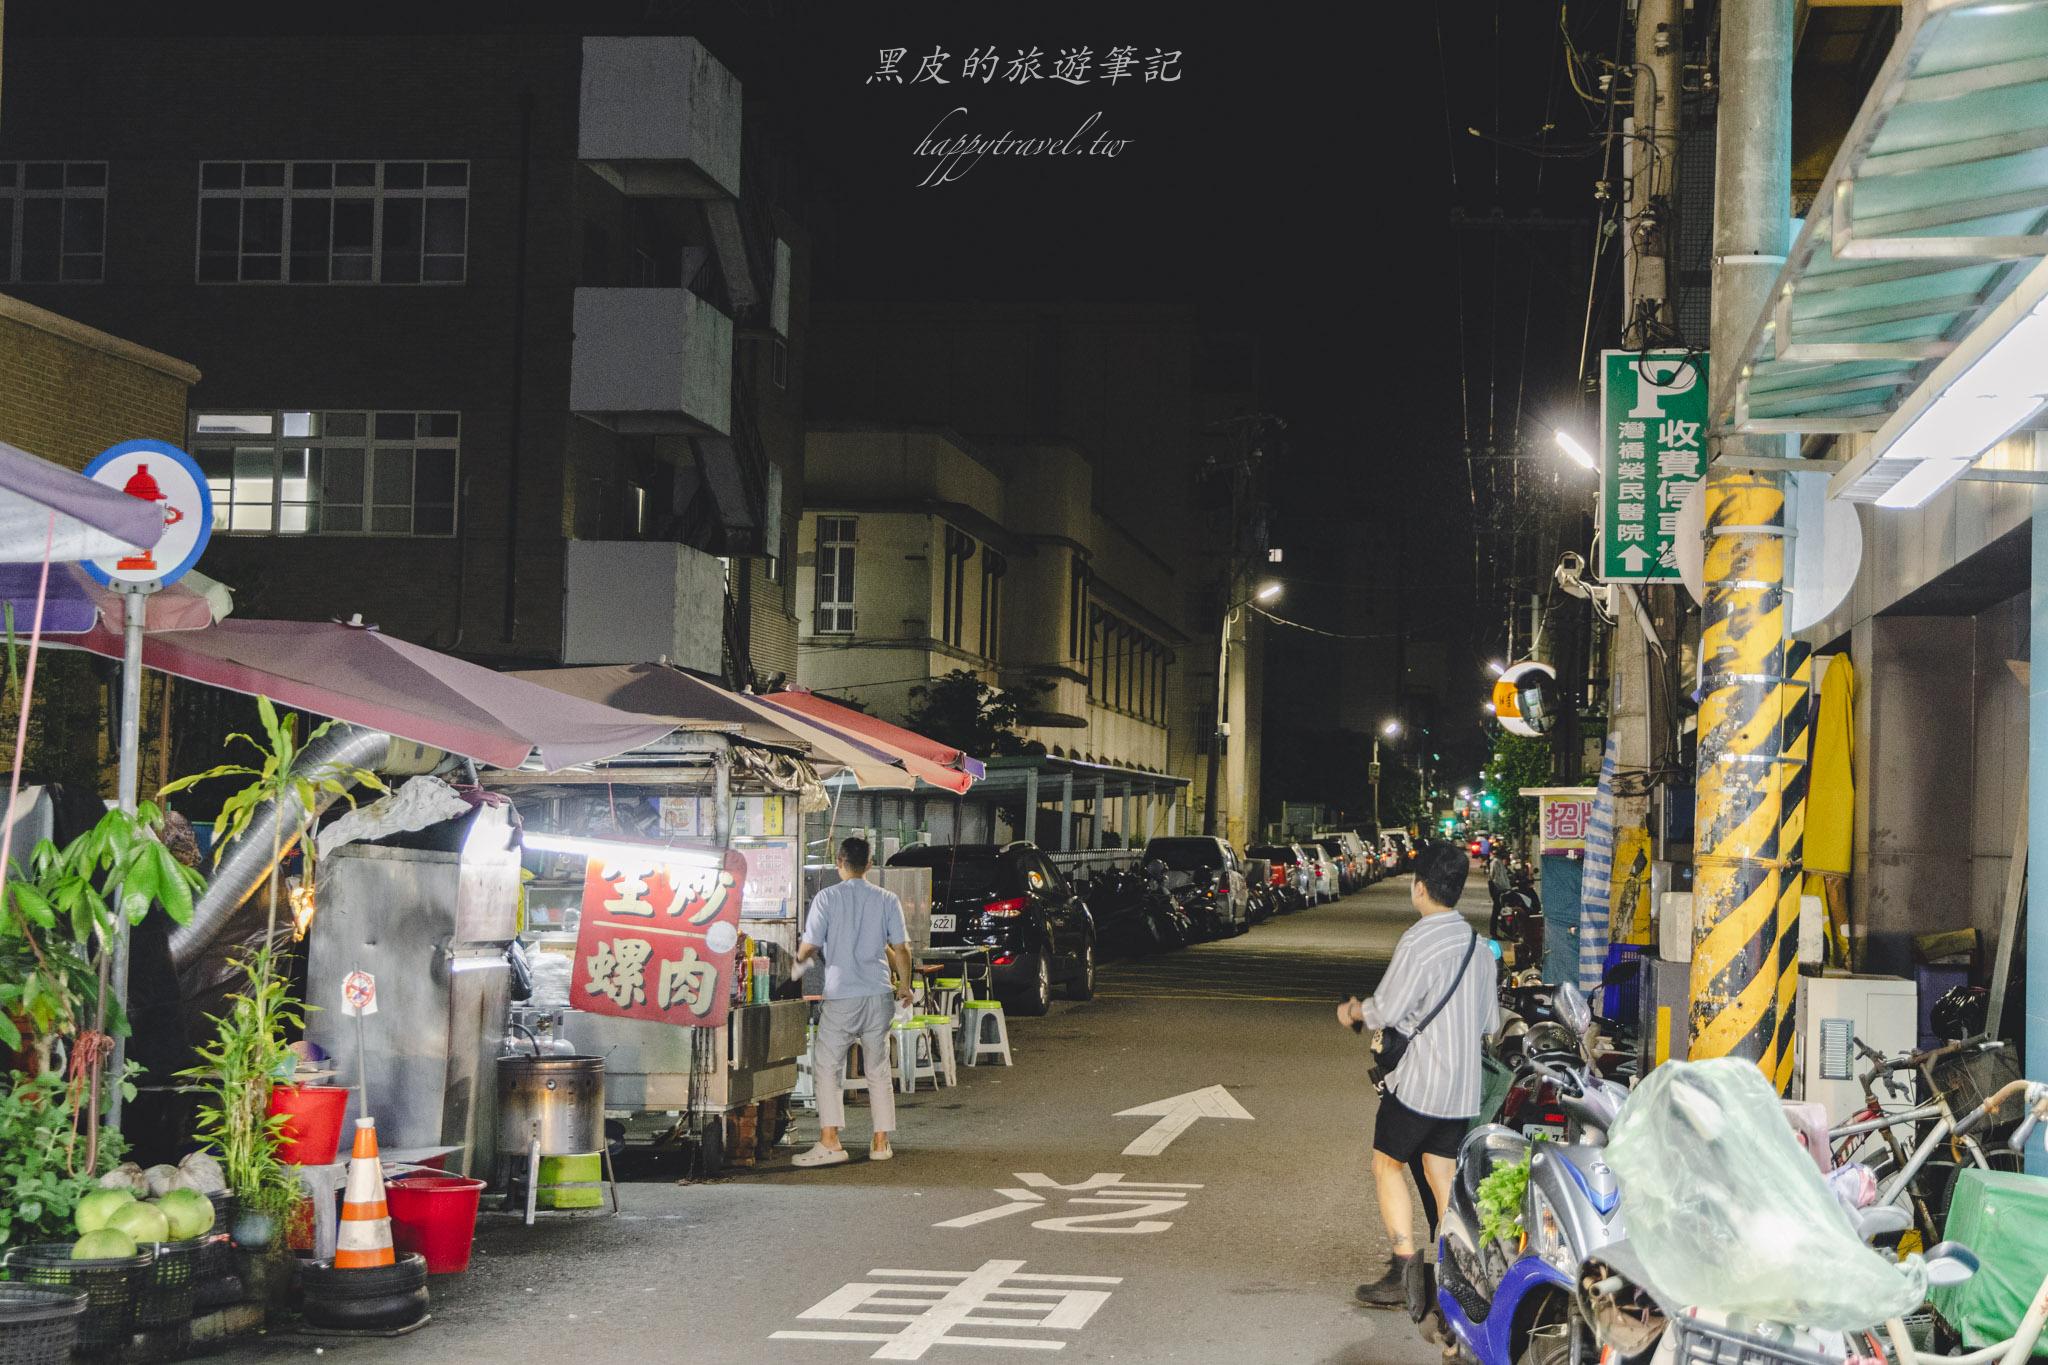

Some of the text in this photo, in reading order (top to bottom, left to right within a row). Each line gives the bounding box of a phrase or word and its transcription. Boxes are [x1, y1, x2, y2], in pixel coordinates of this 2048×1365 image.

[1628, 360, 1698, 418] P
[1617, 421, 1646, 542] 灣橋榮民醫院
[585, 938, 719, 1018] 螺肉
